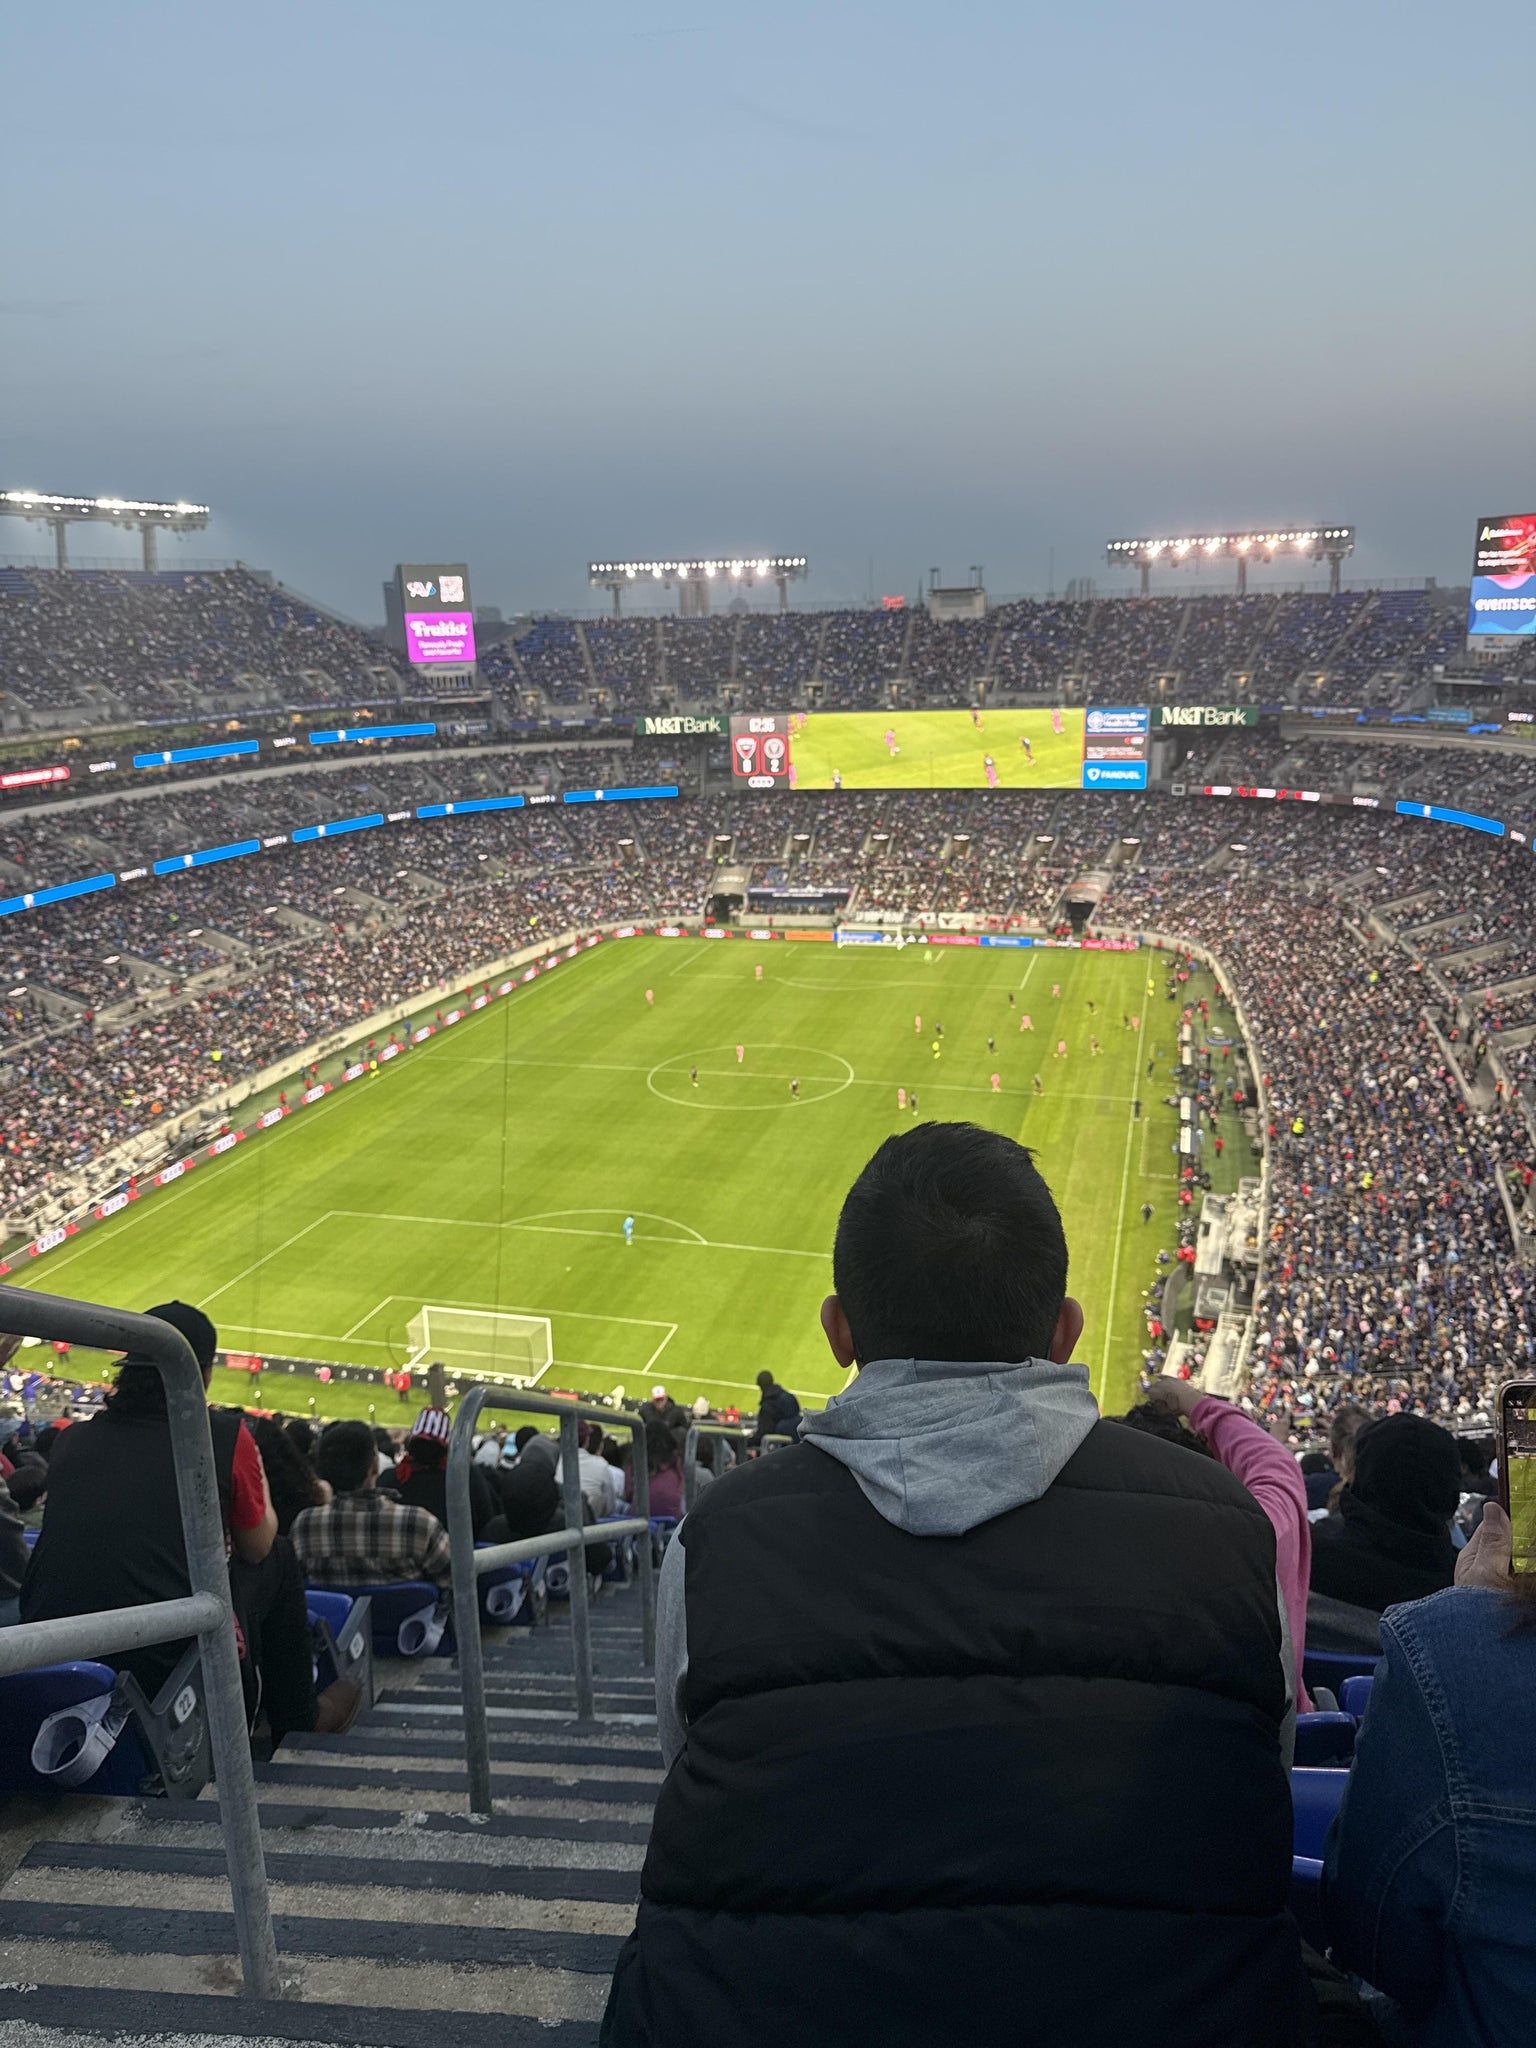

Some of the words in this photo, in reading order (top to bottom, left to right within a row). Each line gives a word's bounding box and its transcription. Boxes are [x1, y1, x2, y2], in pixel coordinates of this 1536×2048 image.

[1161, 706, 1205, 725] M&T
[1204, 707, 1247, 725] Bank
[644, 717, 684, 734] M&T
[684, 716, 721, 733] Bank
[770, 759, 780, 773] 2
[179, 1693, 192, 1716] 22
